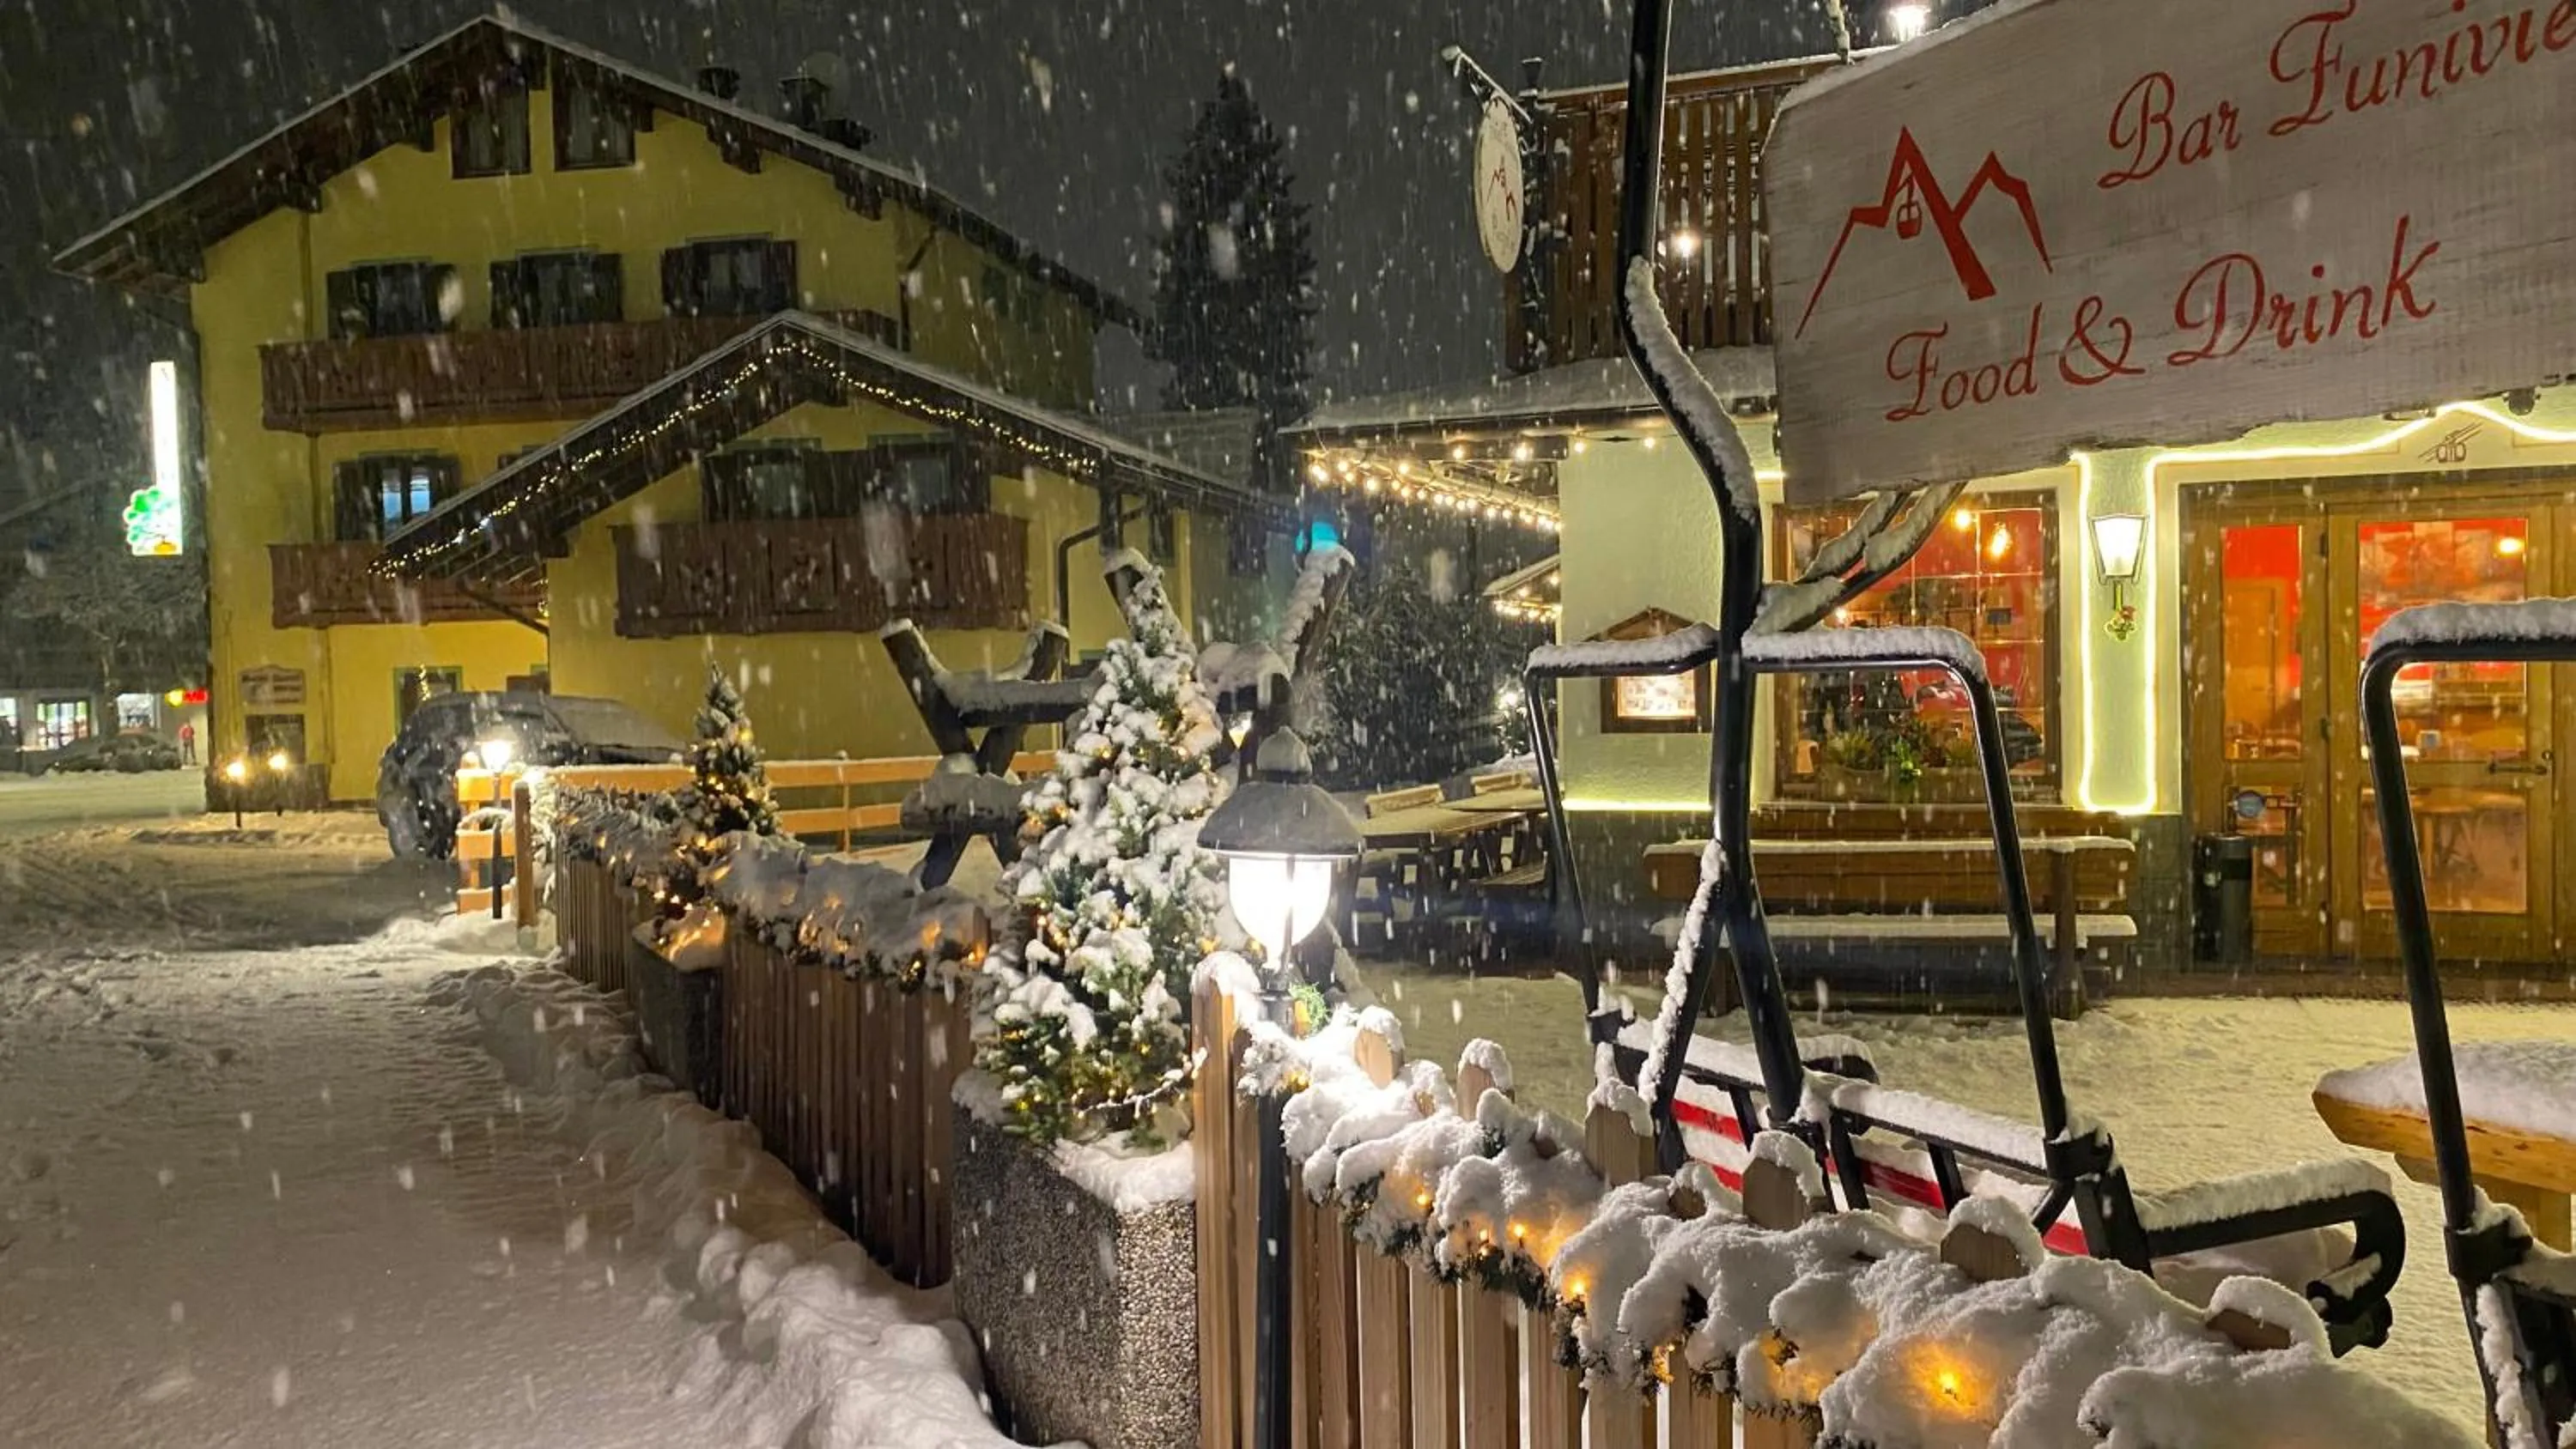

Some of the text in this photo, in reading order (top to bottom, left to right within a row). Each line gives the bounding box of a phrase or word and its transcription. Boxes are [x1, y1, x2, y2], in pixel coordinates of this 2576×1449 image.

[2097, 71, 2243, 189] Bar
[1886, 215, 2440, 421] Food & Drink
